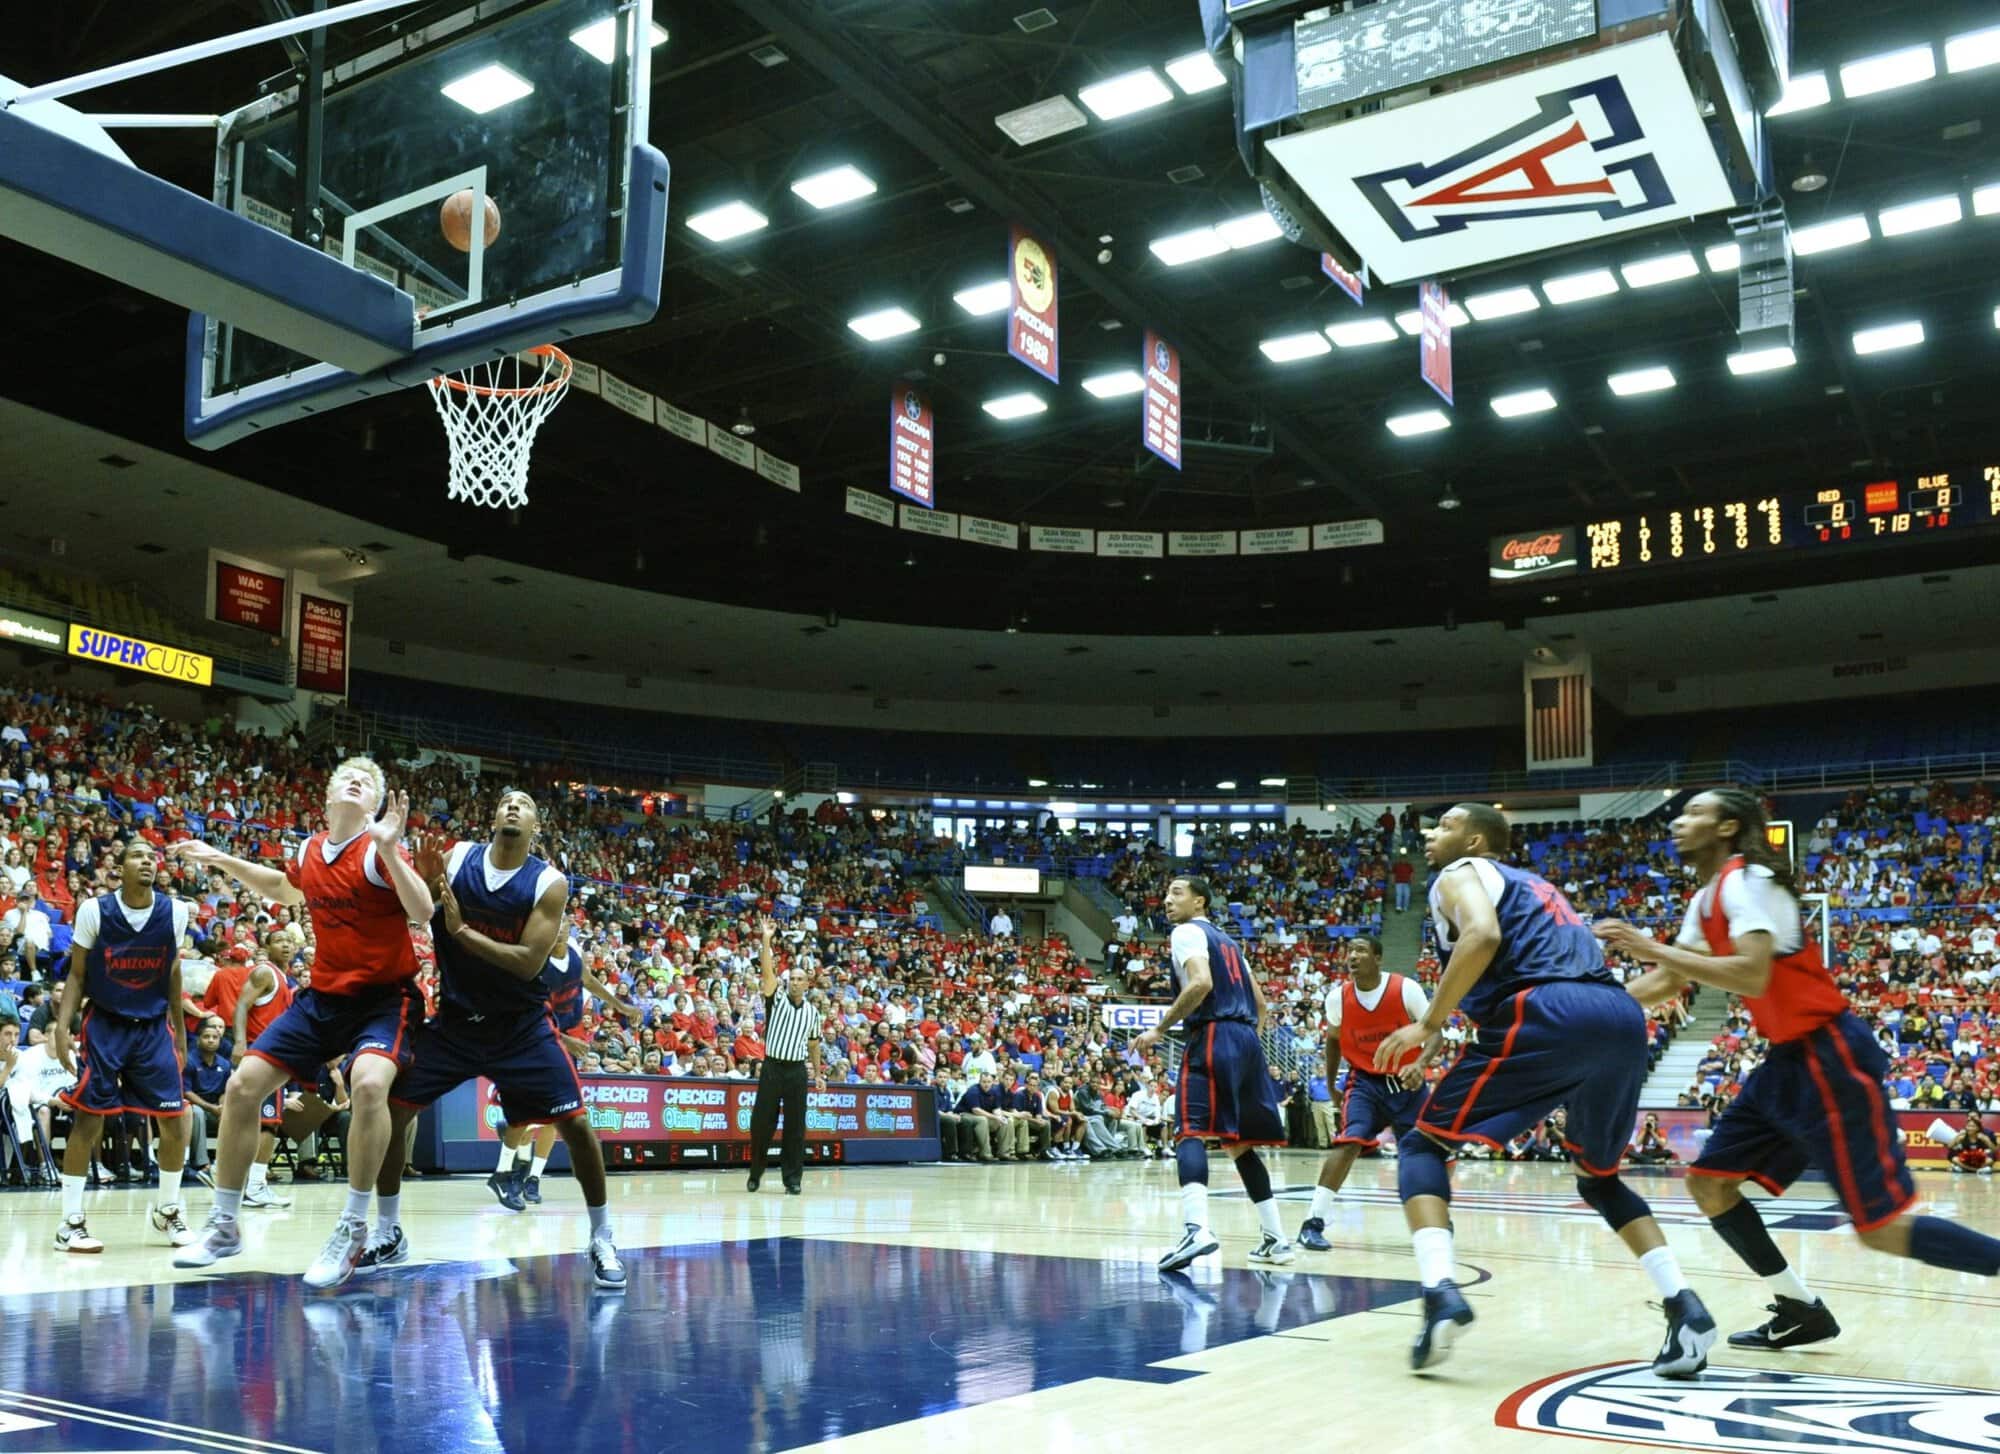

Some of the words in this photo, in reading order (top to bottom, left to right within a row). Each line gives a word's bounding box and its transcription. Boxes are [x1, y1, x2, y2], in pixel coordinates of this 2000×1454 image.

[1014, 306, 1054, 342] ARIZONA
[1019, 332, 1048, 365] 1988
[896, 414, 930, 441] ARIZONA
[1918, 475, 1949, 489] BLUE
[1818, 490, 1840, 503] RED
[1937, 489, 1950, 507] 8
[1640, 516, 1646, 528] 1
[1694, 507, 1714, 521] 12
[1757, 498, 1779, 512] 44
[1832, 503, 1844, 521] 8
[1869, 513, 1910, 535] 7:18
[1639, 528, 1651, 539] 0
[1672, 534, 1683, 546] 0
[1736, 526, 1748, 537] 0
[1640, 550, 1652, 562] 0
[1672, 546, 1684, 557] 0
[1704, 541, 1716, 553] 0
[1769, 532, 1781, 544] 0
[238, 575, 264, 591] WAC
[307, 601, 341, 618] Pac-10
[77, 630, 201, 680] SUPERCUTS
[582, 1086, 649, 1103] CHECKER
[664, 1088, 726, 1105] CHECKER
[806, 1093, 857, 1108] CHECKER
[866, 1094, 913, 1109] CHECKER
[623, 1120, 650, 1129] PARTS
[624, 1112, 649, 1121] AUTO
[662, 1107, 704, 1132] O'Reilly
[704, 1113, 726, 1121] AUTO
[703, 1120, 728, 1130] PARTS
[838, 1122, 859, 1130] PARTS
